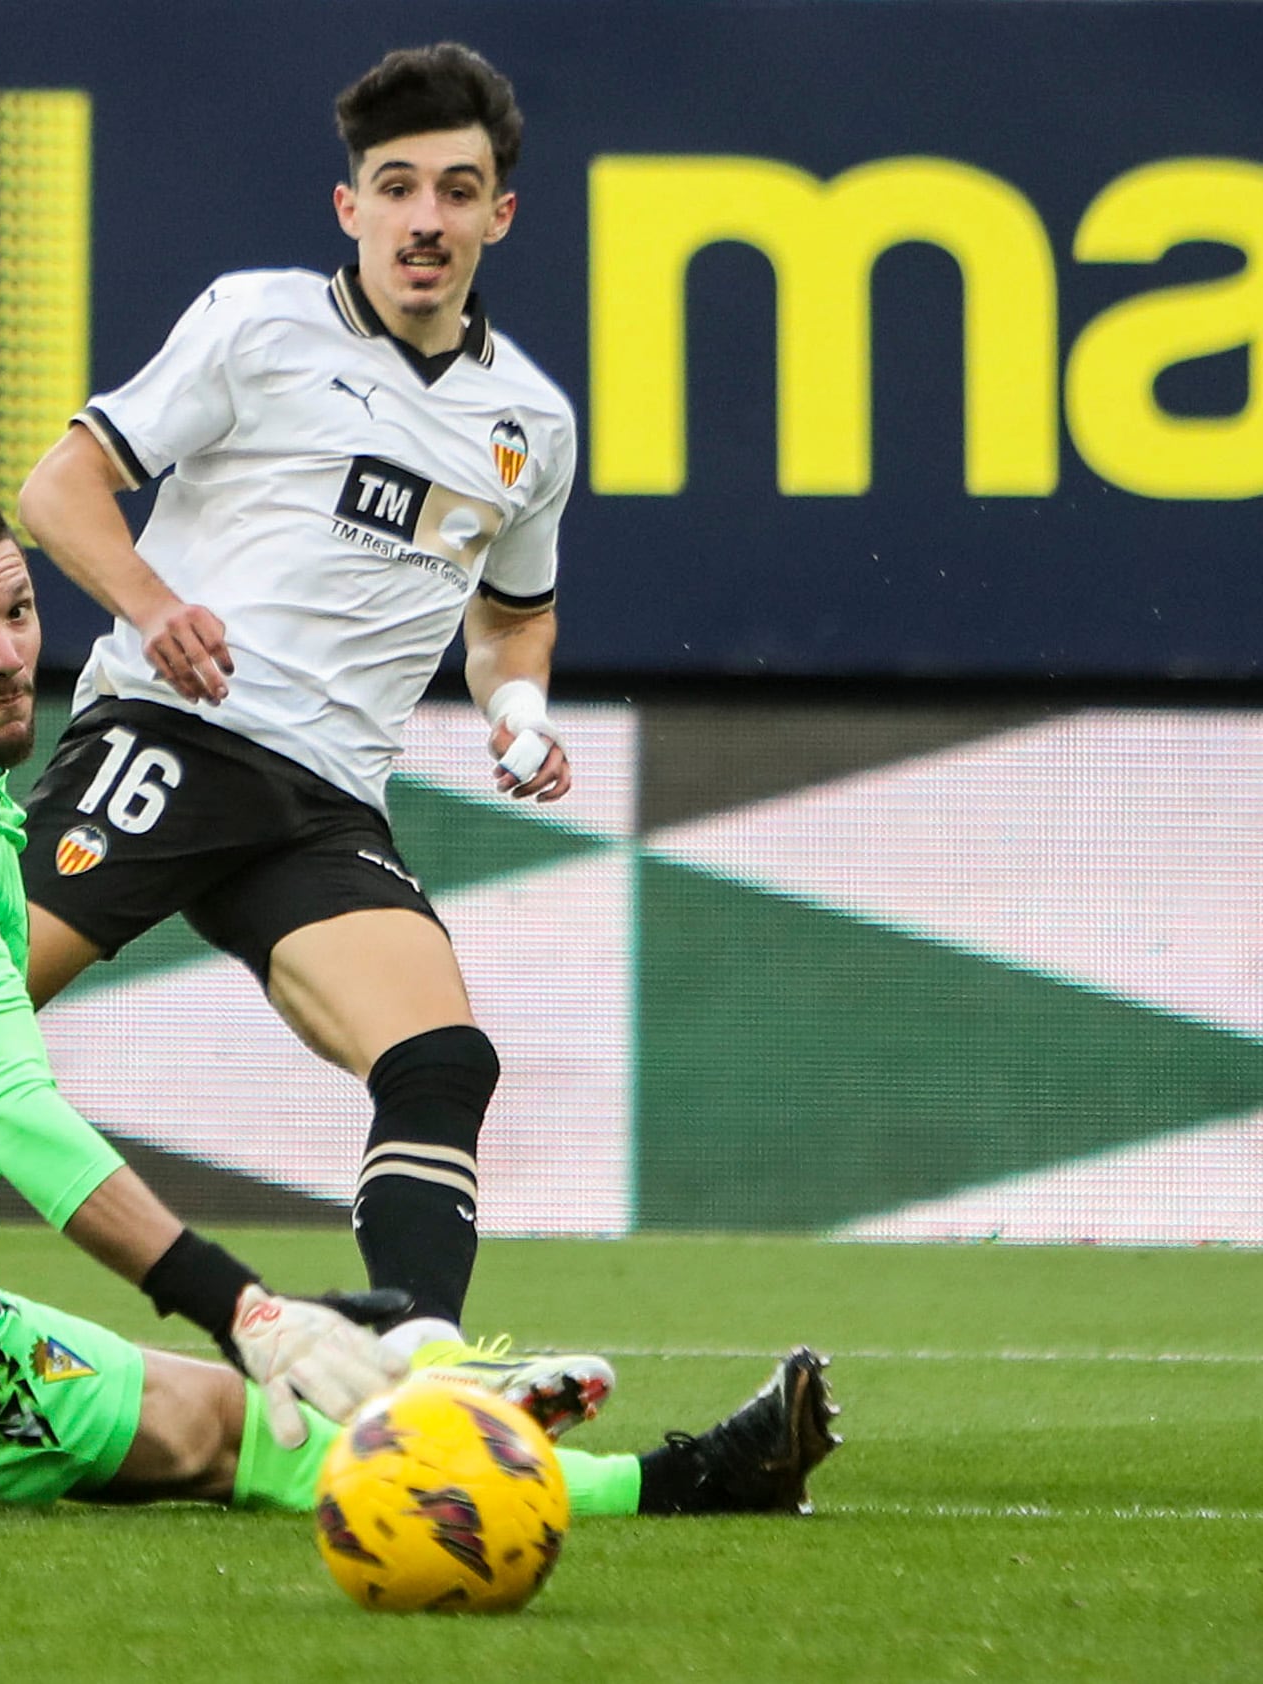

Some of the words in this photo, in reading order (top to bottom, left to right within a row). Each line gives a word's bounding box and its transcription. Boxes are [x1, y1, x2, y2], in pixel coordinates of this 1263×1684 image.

[356, 473, 413, 527] TM
[331, 519, 358, 542] TM
[361, 532, 394, 560] Real
[76, 726, 182, 835] 16
